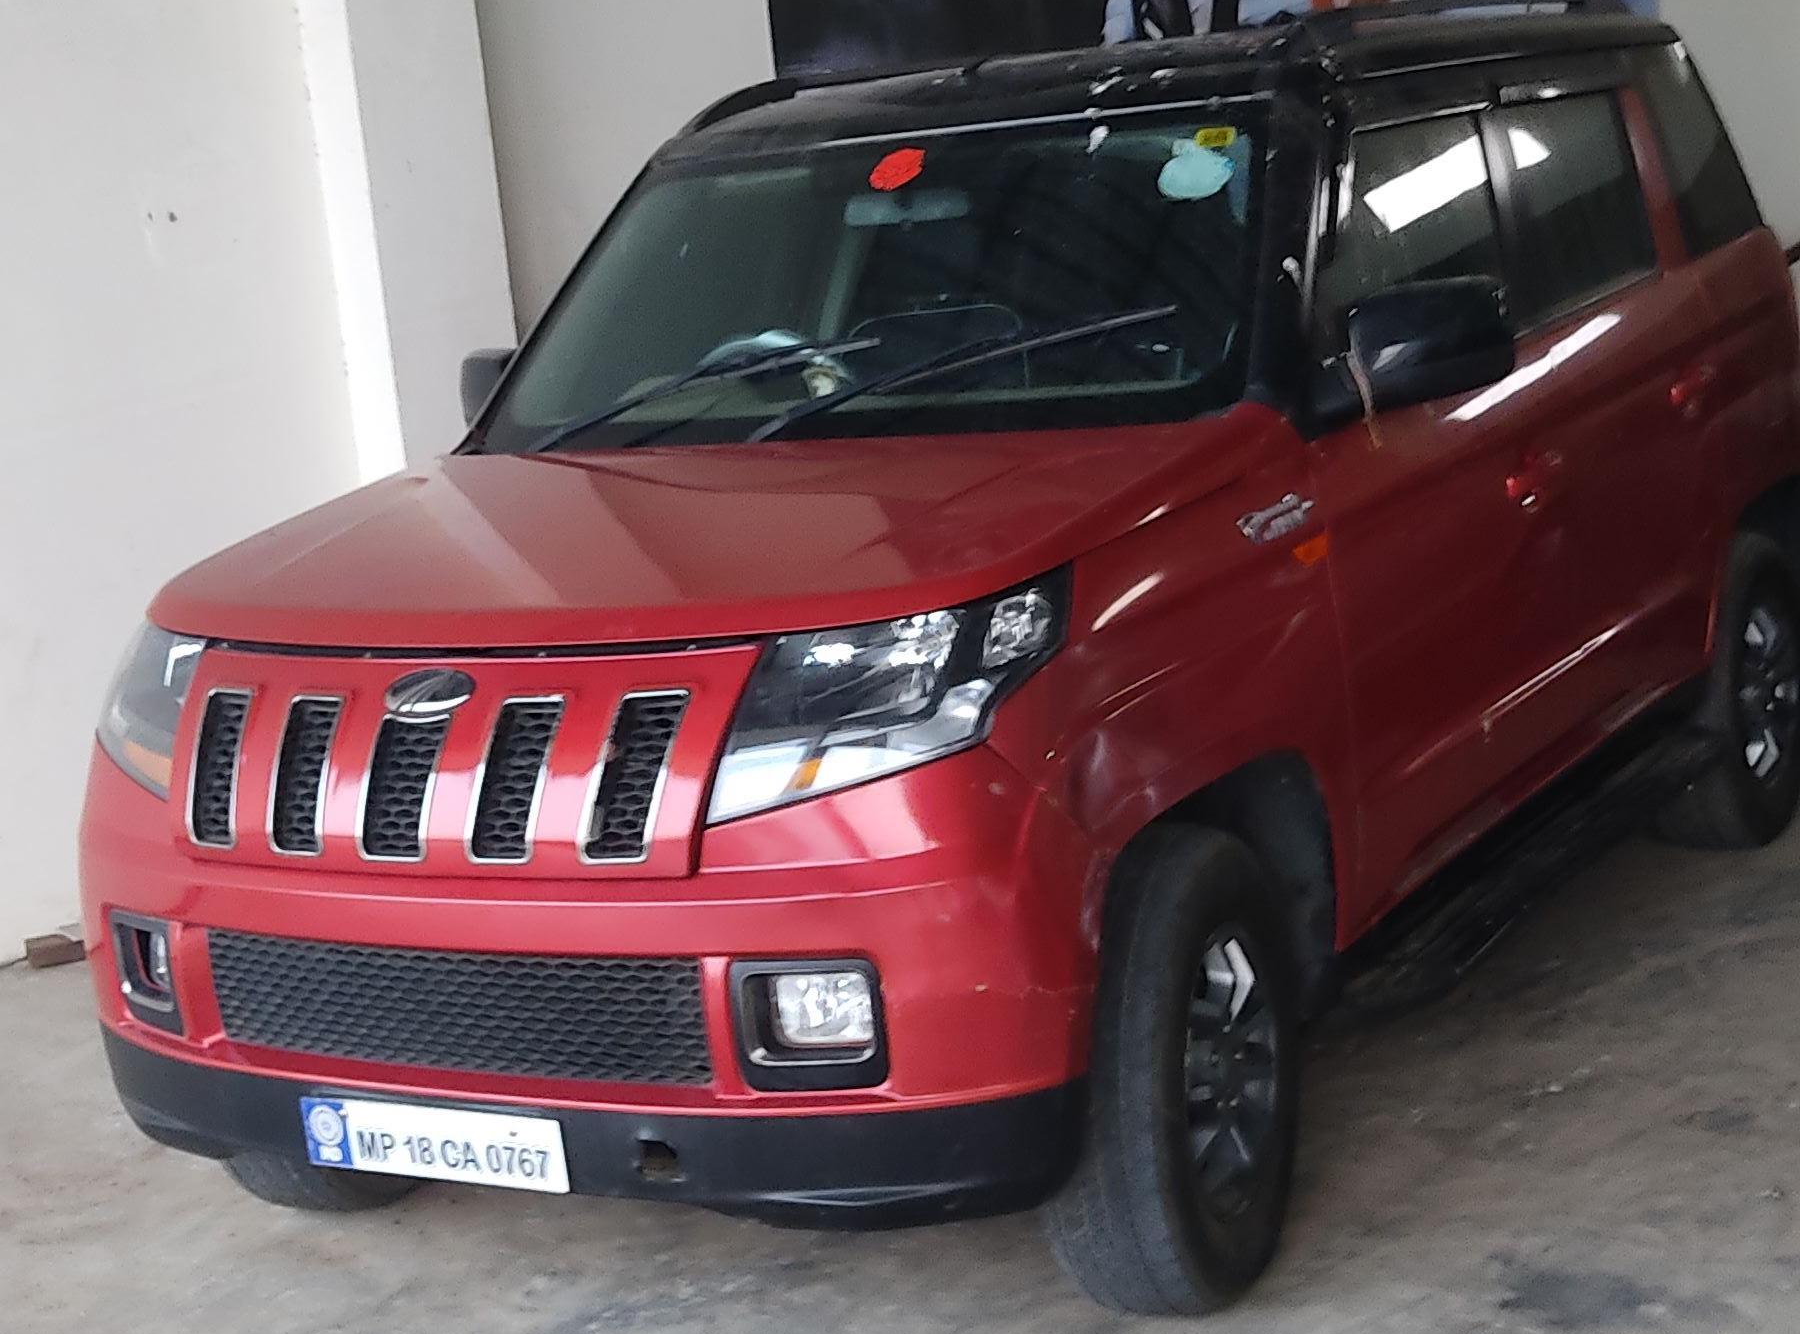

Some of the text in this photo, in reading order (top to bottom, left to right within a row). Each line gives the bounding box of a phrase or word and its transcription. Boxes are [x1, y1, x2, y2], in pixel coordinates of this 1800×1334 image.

[356, 1130, 396, 1163] MP
[404, 1136, 434, 1166] 18
[440, 1139, 481, 1171] CA
[486, 1144, 550, 1179] 0767
